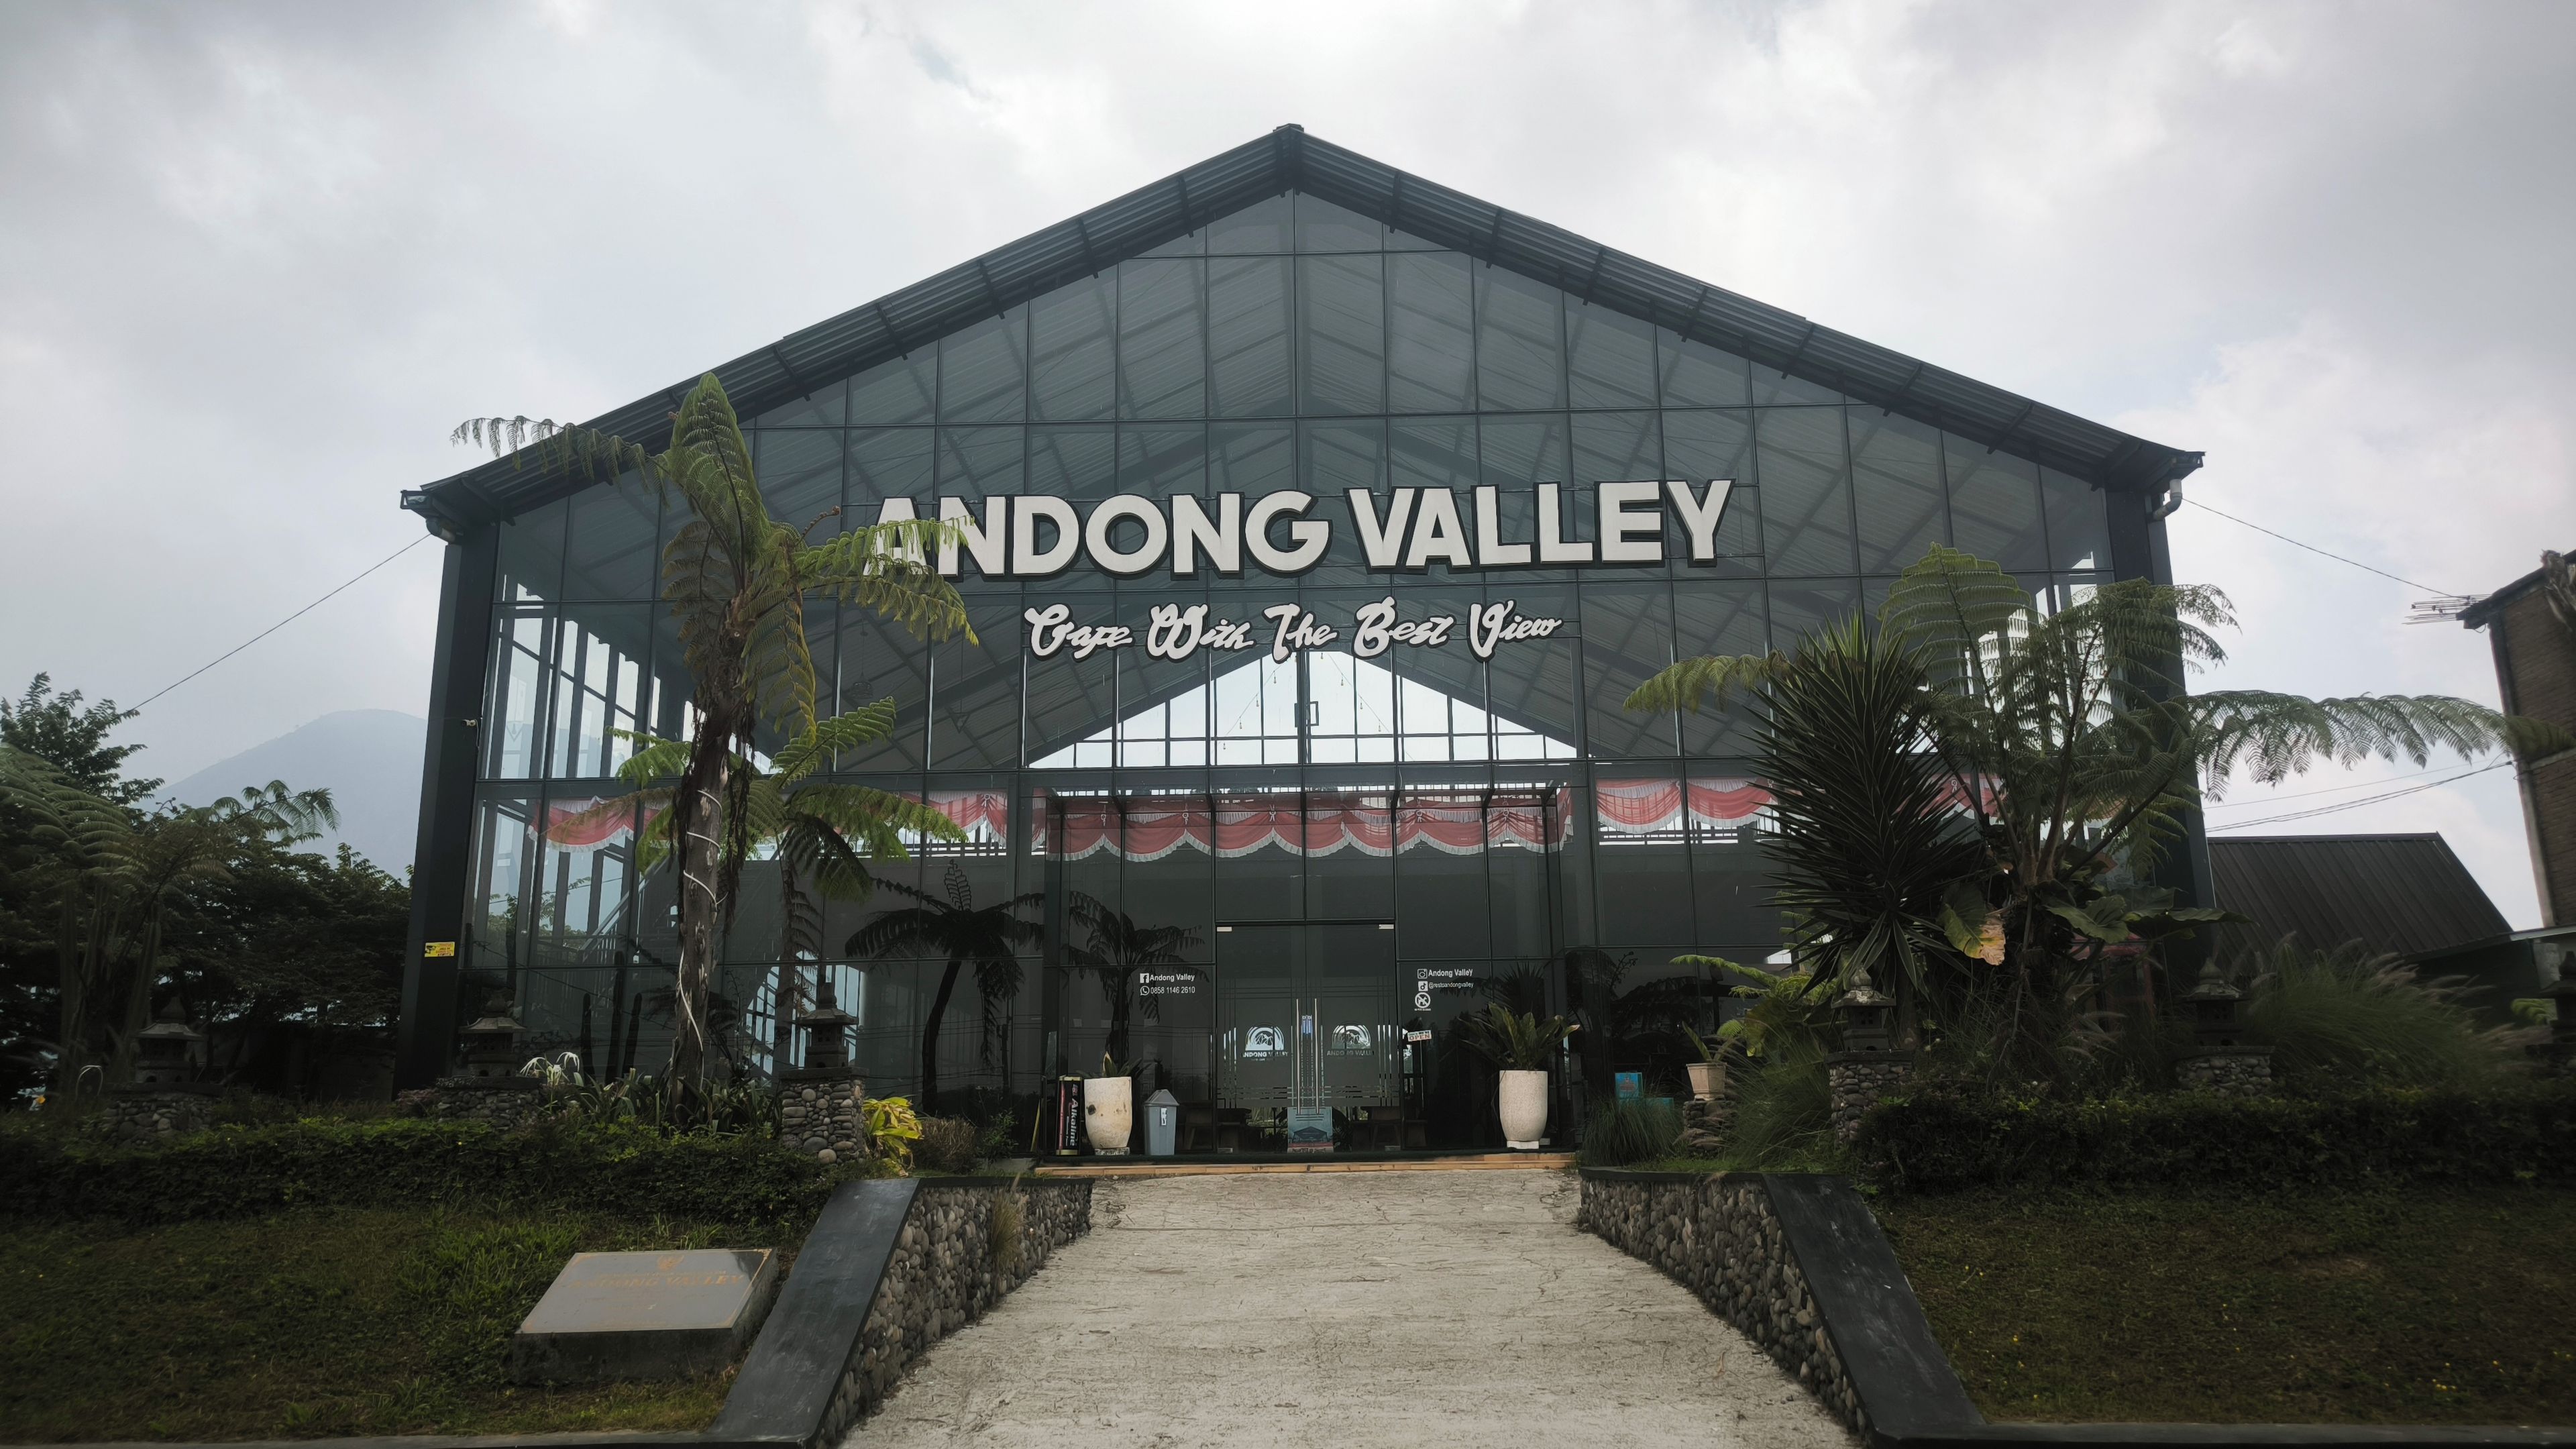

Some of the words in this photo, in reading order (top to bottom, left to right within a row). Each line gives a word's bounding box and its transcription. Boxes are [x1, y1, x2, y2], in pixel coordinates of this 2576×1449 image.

[863, 490, 1330, 576] ANDONG
[1349, 480, 1732, 568] VALLEY
[1024, 604, 1133, 659] Cafe
[1147, 603, 1254, 659] With
[1264, 603, 1337, 661] The
[1354, 596, 1454, 657] Best
[1470, 600, 1562, 657] View
[1149, 974, 1175, 982] Andong
[1176, 973, 1195, 981] Valley
[1428, 969, 1453, 977] Andong
[1409, 1032, 1430, 1040] OPEN
[1070, 1098, 1079, 1146] Alkaline
